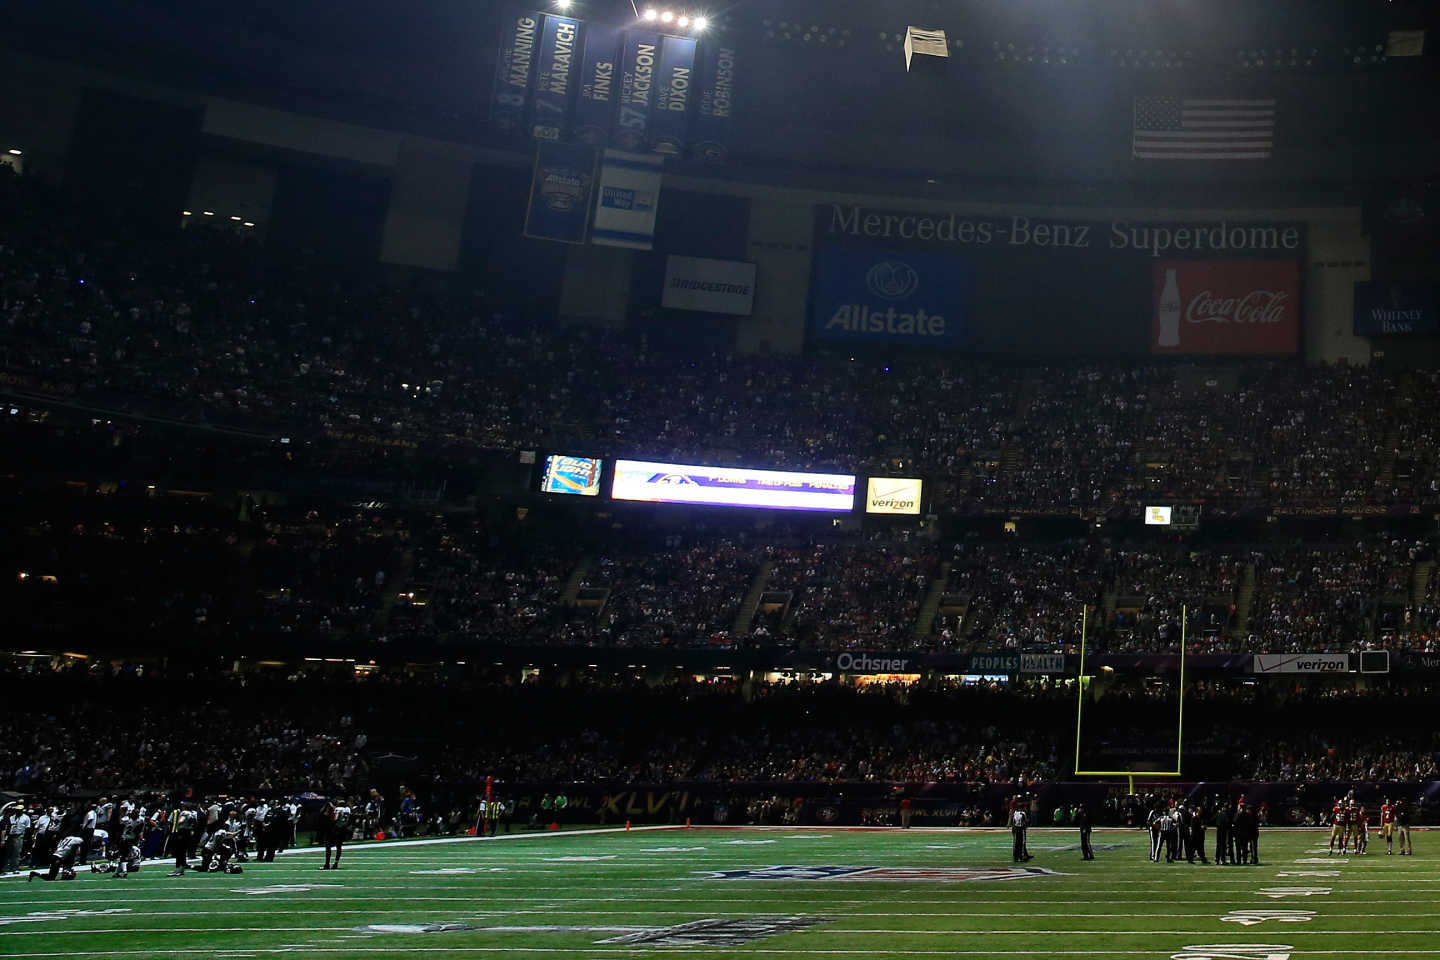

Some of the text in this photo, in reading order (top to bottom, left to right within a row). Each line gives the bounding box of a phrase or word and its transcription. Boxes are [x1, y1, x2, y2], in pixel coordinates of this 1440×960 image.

[510, 16, 535, 88] MANNING
[550, 22, 576, 96] MARAVICH
[592, 61, 613, 102] FINKS
[632, 43, 656, 105] JACKSON
[668, 67, 691, 112] DIXON
[713, 47, 736, 118] ROBINSON
[830, 204, 1301, 256] Mercedes-Benz Superdome
[825, 304, 946, 337] Allstate
[1370, 306, 1424, 321] WHITNEY
[1383, 321, 1416, 334] BANK
[872, 498, 914, 511] verizon
[836, 653, 910, 672] Ochsner
[971, 656, 1018, 671] PEOPLES
[1296, 659, 1345, 672] verizon
